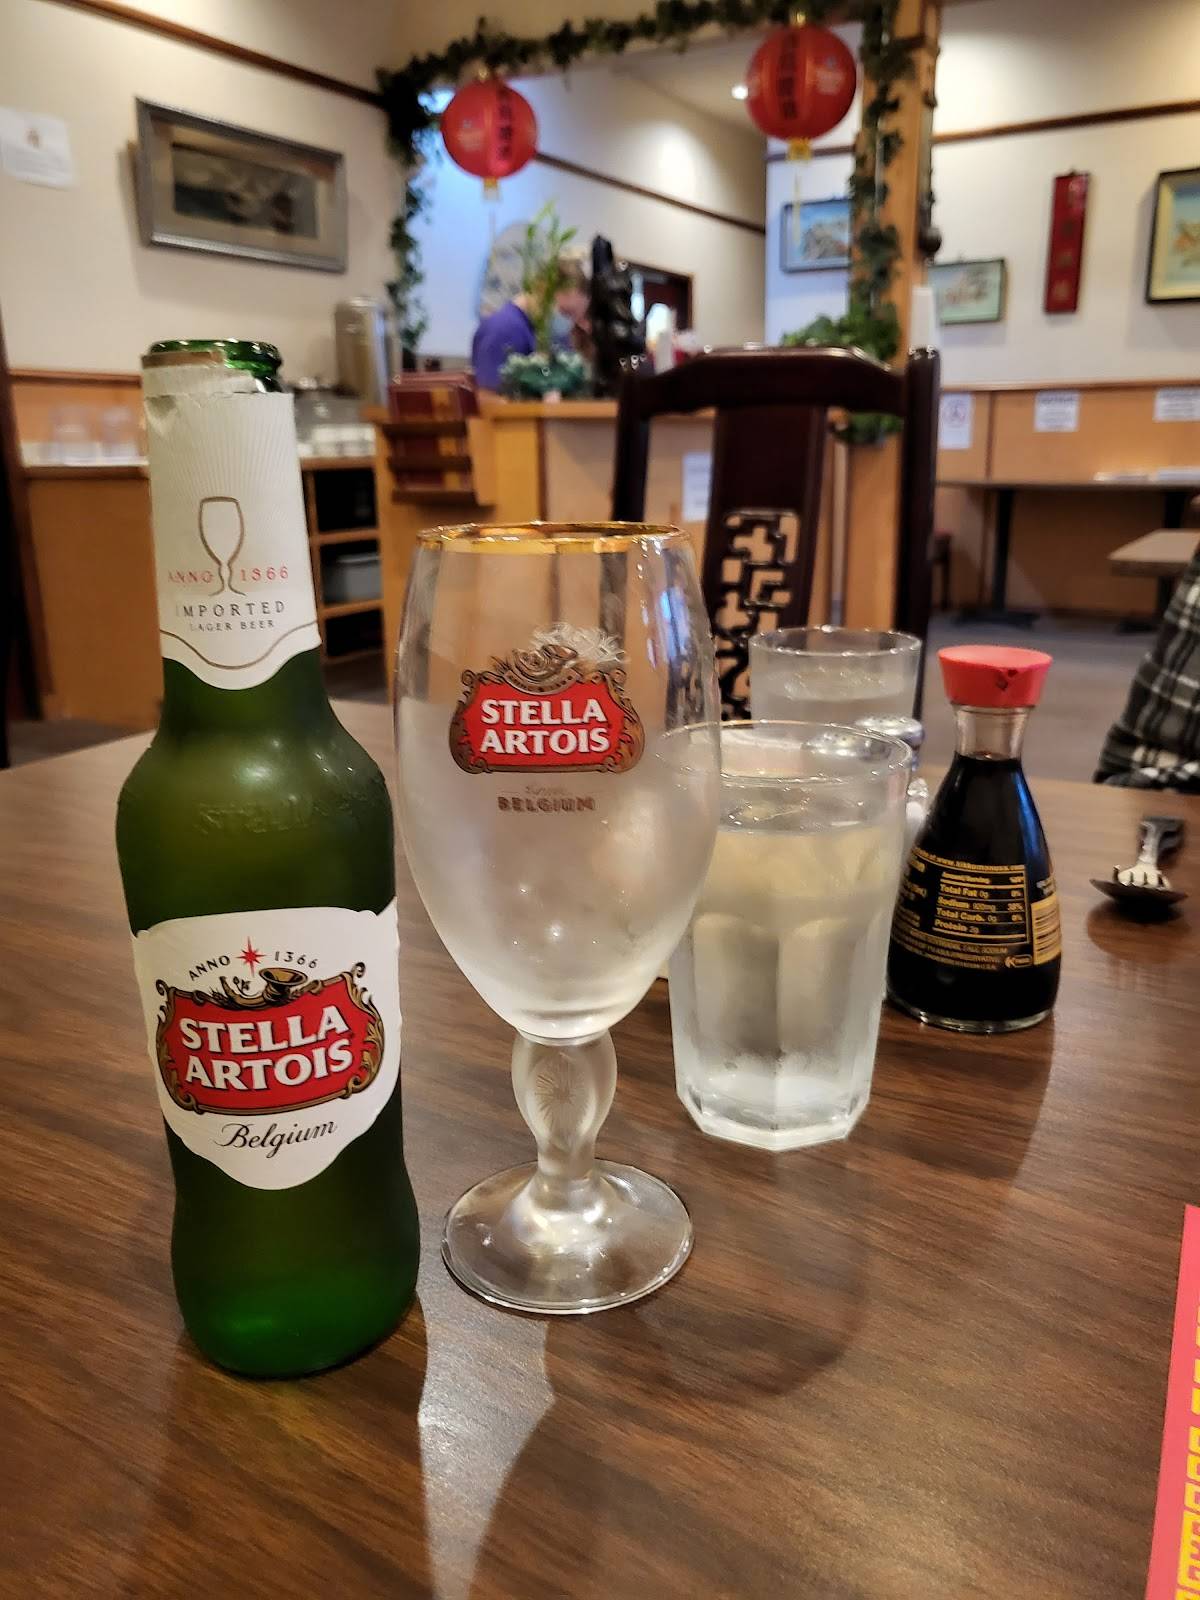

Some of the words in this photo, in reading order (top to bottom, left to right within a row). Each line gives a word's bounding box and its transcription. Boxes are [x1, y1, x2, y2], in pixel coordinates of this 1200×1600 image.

[168, 570, 214, 584] ANNO
[175, 600, 285, 618] IMPORTED
[190, 621, 232, 632] LAGER
[240, 619, 274, 630] BEER
[481, 698, 608, 725] STELLA
[480, 727, 611, 755] ARTOIS
[497, 796, 596, 813] BELGIUM
[940, 884, 961, 895] Total
[188, 955, 231, 980] ANNO
[274, 951, 319, 969] 1366
[179, 1005, 350, 1054] STELLA
[185, 1039, 353, 1091] ARTOIS
[211, 1120, 338, 1158] Belgium
